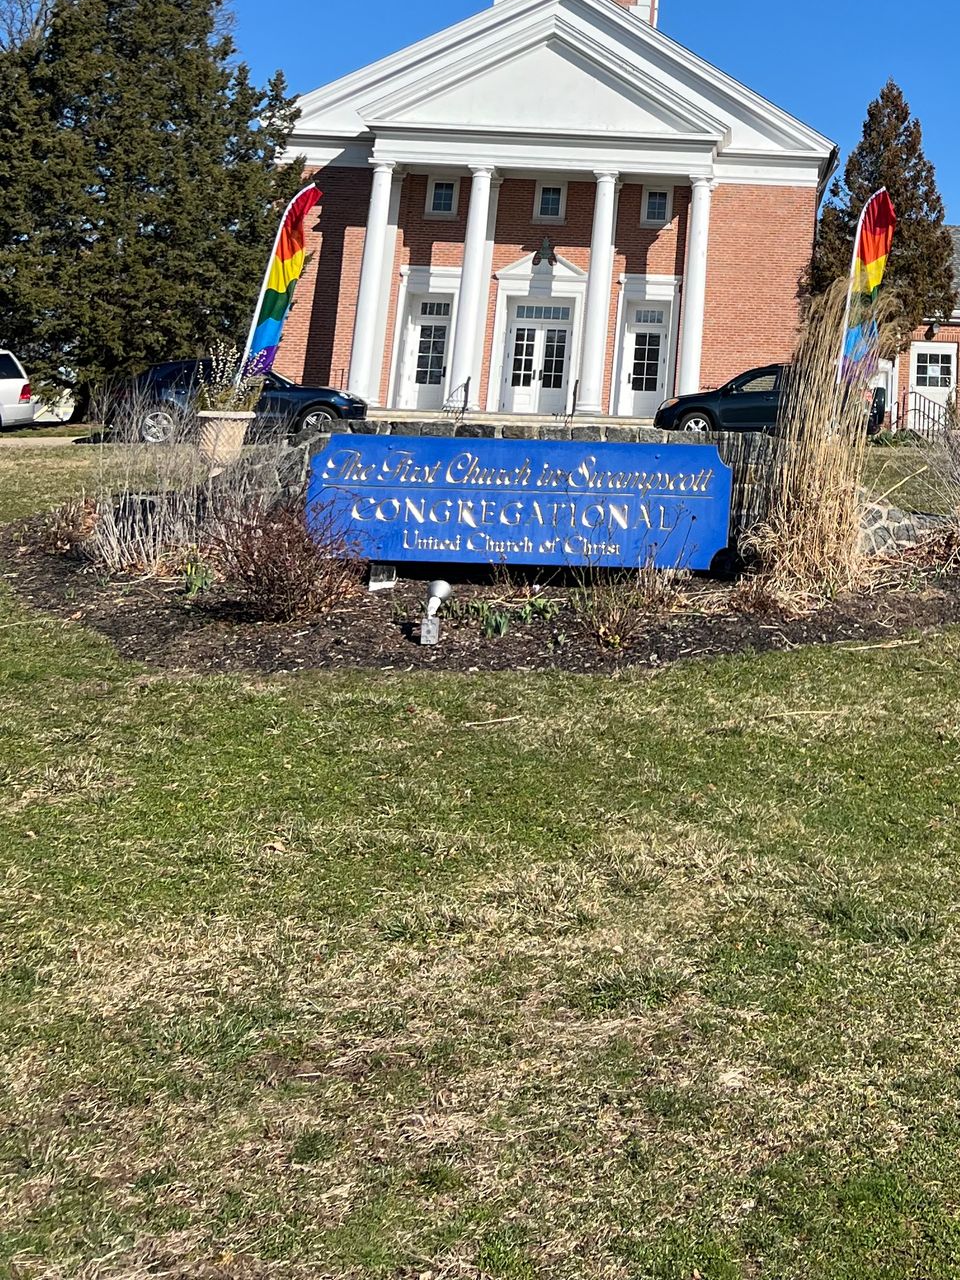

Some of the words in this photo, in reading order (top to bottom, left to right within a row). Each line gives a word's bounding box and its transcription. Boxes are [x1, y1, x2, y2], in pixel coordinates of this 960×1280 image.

[321, 449, 377, 481] The
[377, 450, 442, 484] First
[445, 452, 532, 486] Church
[537, 462, 562, 487] in
[567, 456, 716, 498] Swampscott
[350, 496, 673, 530] CONGREGATIONAL
[402, 529, 462, 551] United
[466, 531, 533, 553] Church
[538, 536, 561, 553] of
[564, 535, 621, 556] Christ
